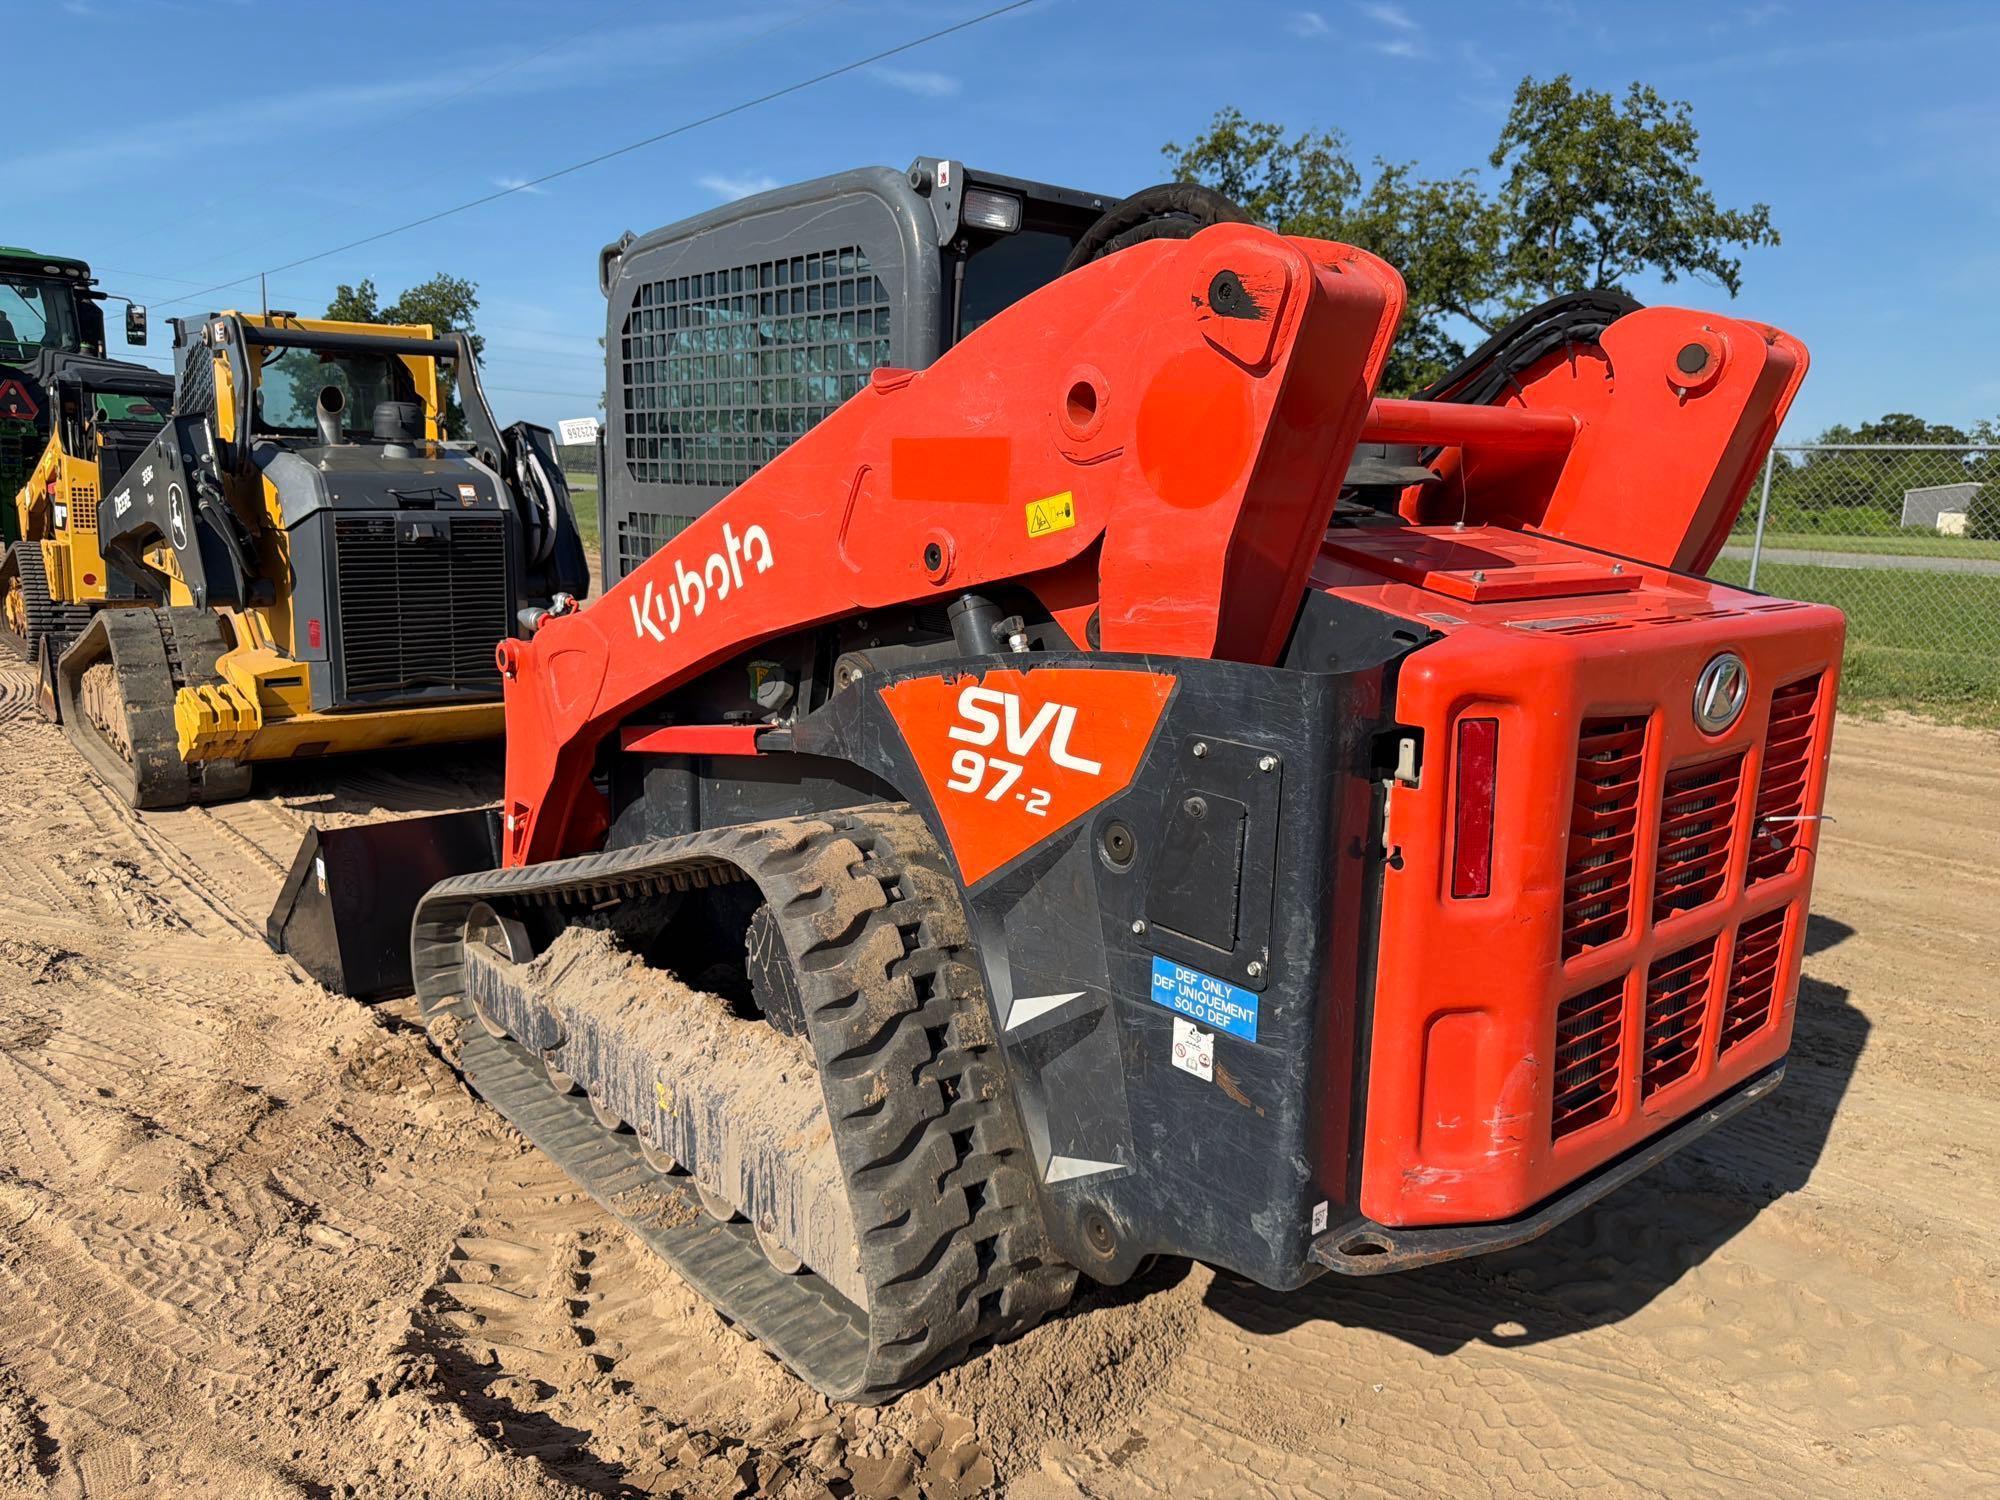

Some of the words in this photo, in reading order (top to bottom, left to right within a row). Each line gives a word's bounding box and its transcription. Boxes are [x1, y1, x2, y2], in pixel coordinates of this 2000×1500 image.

[114, 487, 132, 518] DEERE
[629, 522, 774, 643] Kubota
[948, 685, 1102, 776] SVL
[1153, 973, 1176, 991] DEF
[1178, 982, 1255, 1024] UNIQUEMENT
[1175, 967, 1198, 986] DEF
[1201, 978, 1232, 1000] ONLY
[1174, 996, 1204, 1017] SOLO
[1207, 1008, 1231, 1028] DEF
